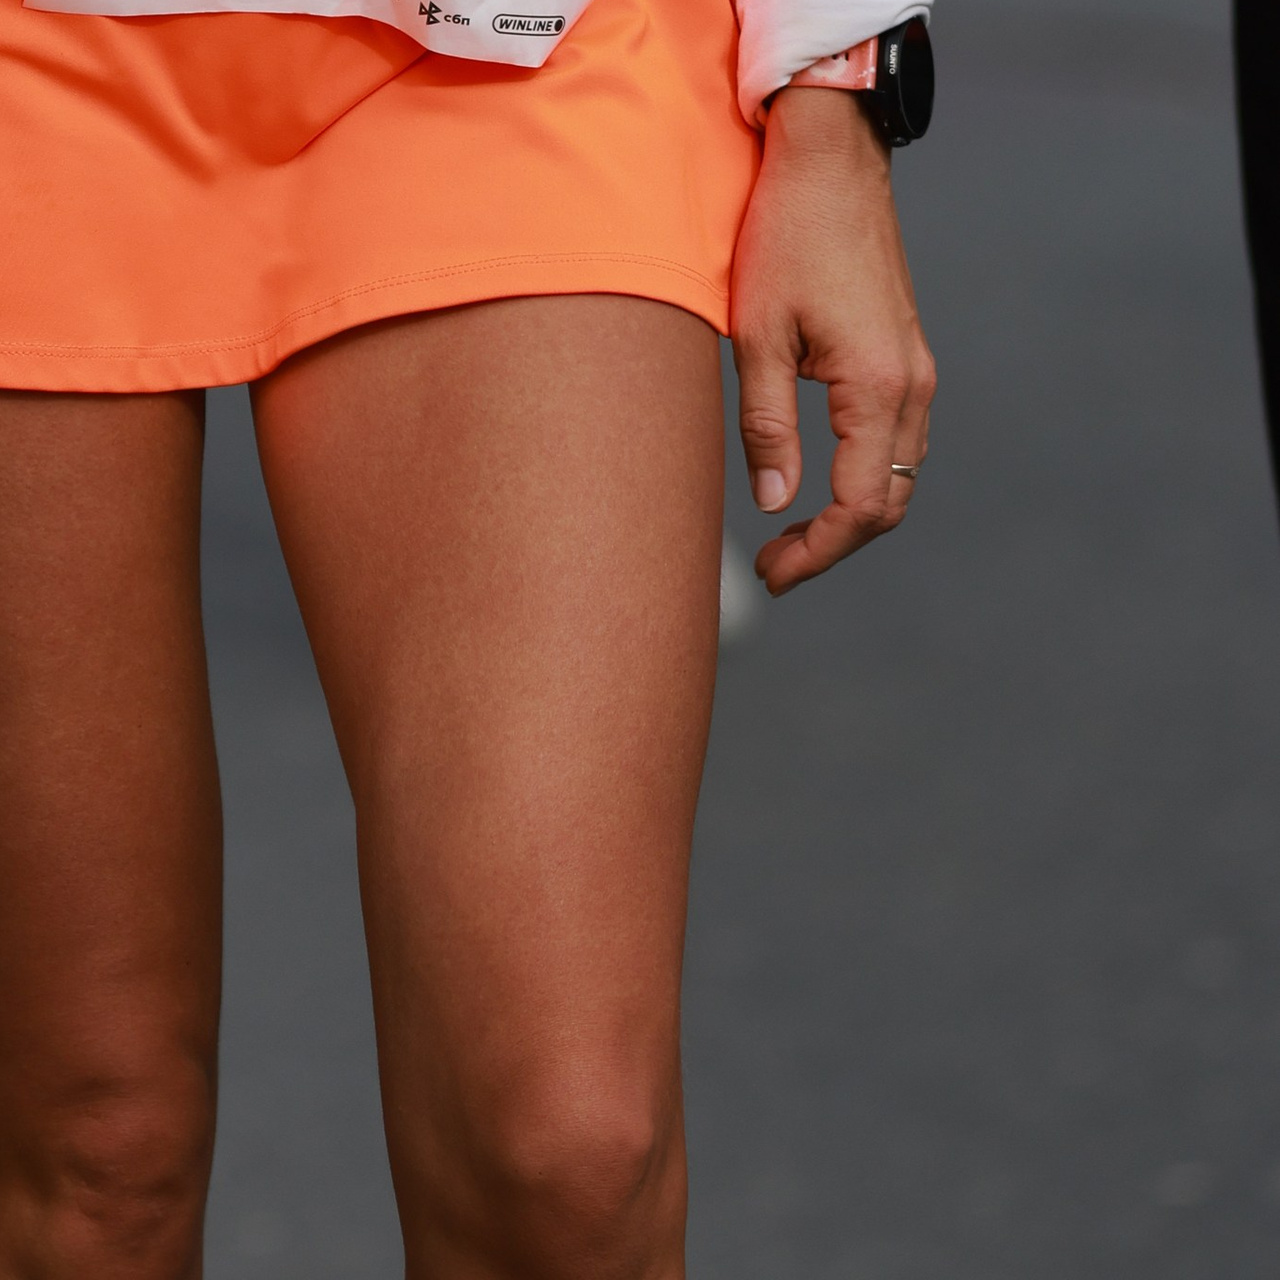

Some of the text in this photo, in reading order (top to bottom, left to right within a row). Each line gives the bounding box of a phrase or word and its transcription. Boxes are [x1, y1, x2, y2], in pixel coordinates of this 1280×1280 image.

[443, 16, 471, 26] сбп
[499, 18, 554, 32] WINLINE
[889, 44, 898, 75] SUUNTO
